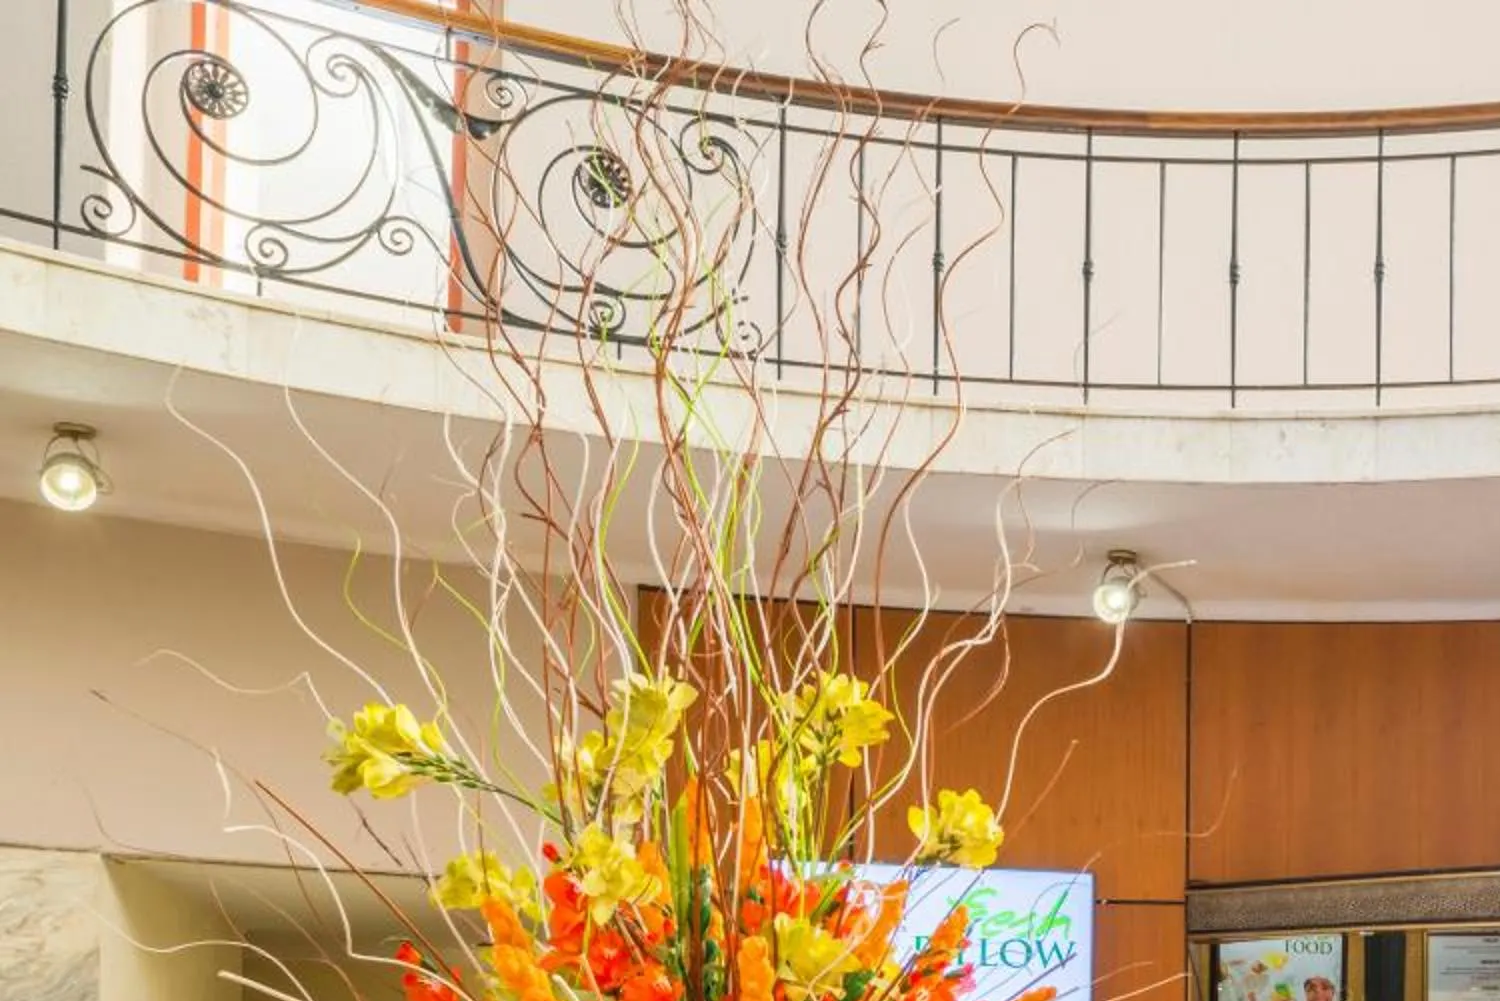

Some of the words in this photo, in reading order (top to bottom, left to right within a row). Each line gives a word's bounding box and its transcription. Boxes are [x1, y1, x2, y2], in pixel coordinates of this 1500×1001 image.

[948, 886, 1071, 940] Fesh
[911, 935, 1077, 969] PLOW
[1285, 939, 1333, 956] FOOD
